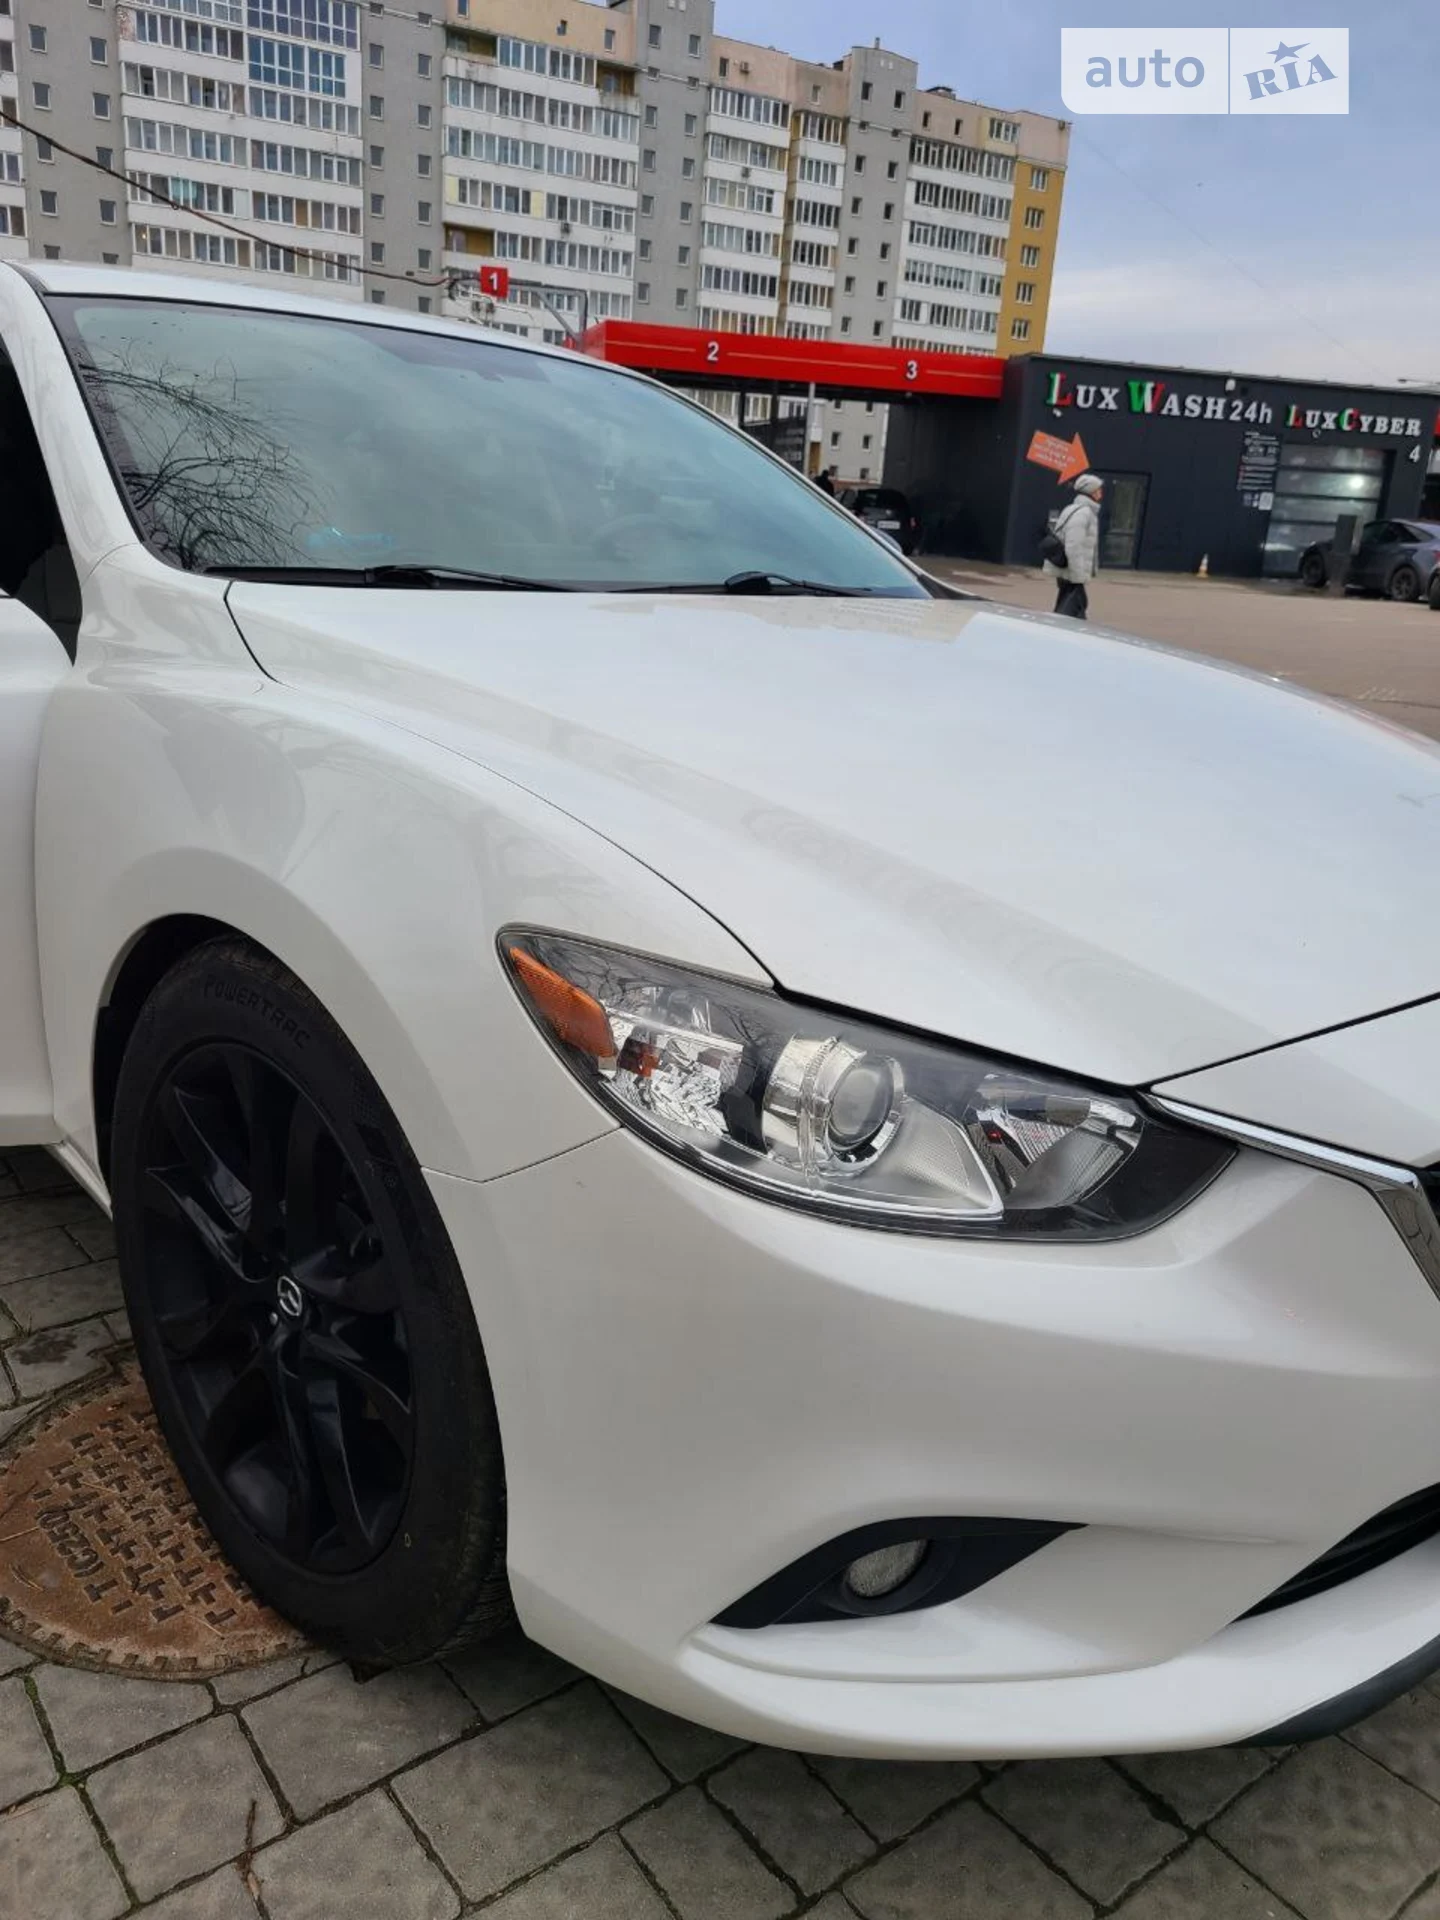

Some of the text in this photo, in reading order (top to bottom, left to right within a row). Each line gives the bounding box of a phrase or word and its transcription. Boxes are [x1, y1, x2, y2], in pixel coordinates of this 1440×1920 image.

[490, 272, 498, 291] 1
[706, 341, 719, 361] 2
[905, 360, 918, 381] 3
[1409, 445, 1421, 463] 4
